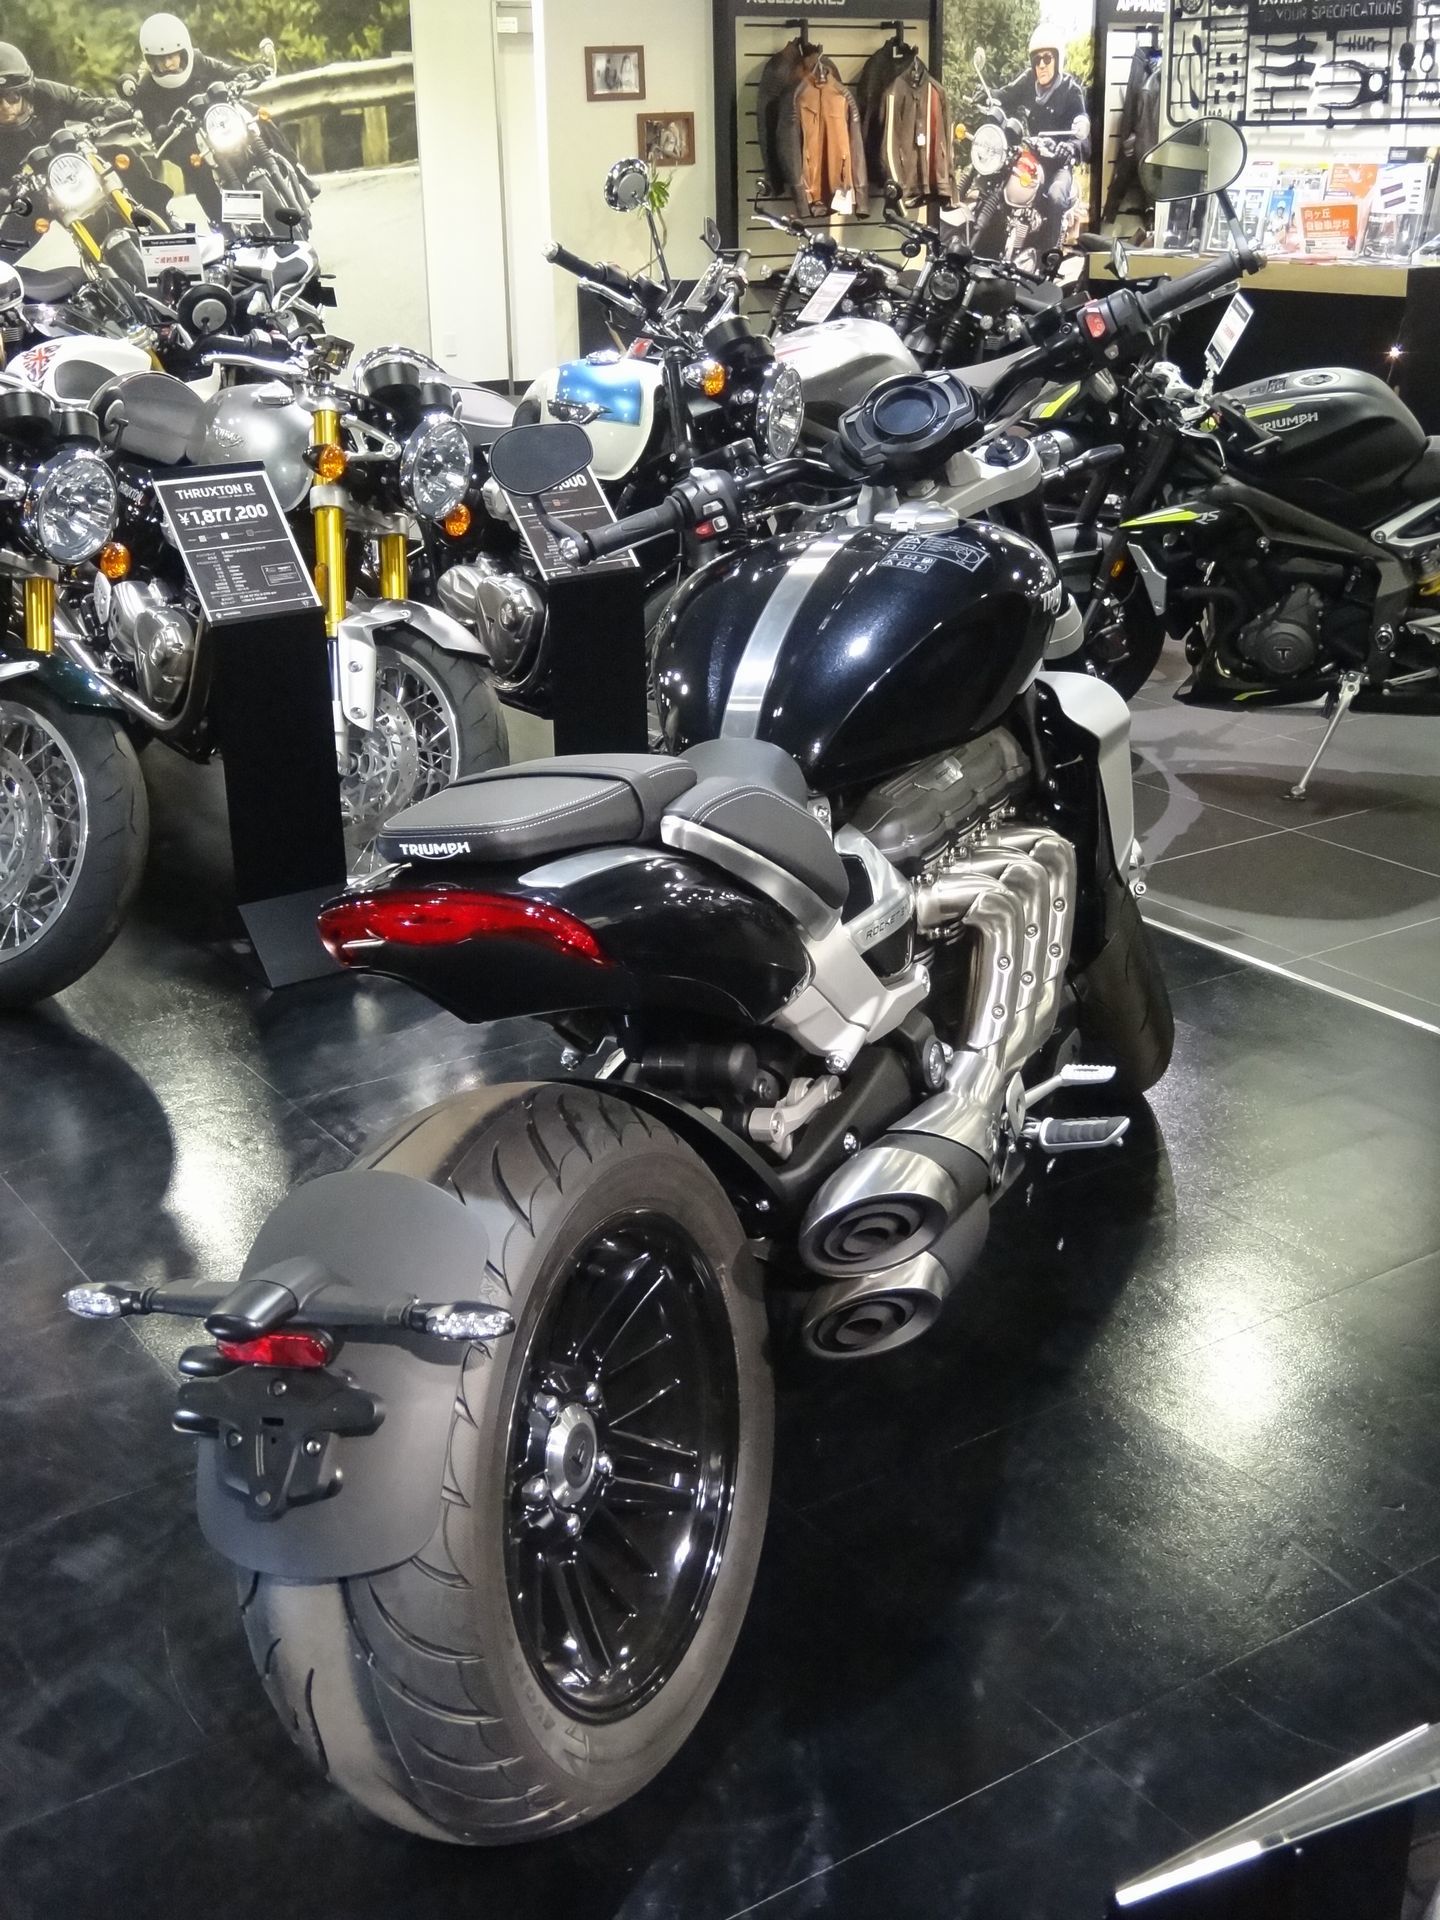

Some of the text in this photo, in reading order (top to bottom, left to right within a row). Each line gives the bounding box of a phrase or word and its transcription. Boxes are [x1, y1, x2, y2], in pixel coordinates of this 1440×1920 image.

[174, 483, 242, 500] THRUXTON
[244, 483, 255, 493] R
[177, 503, 269, 526] ¥1,877,200
[399, 841, 471, 860] TRIUMPH
